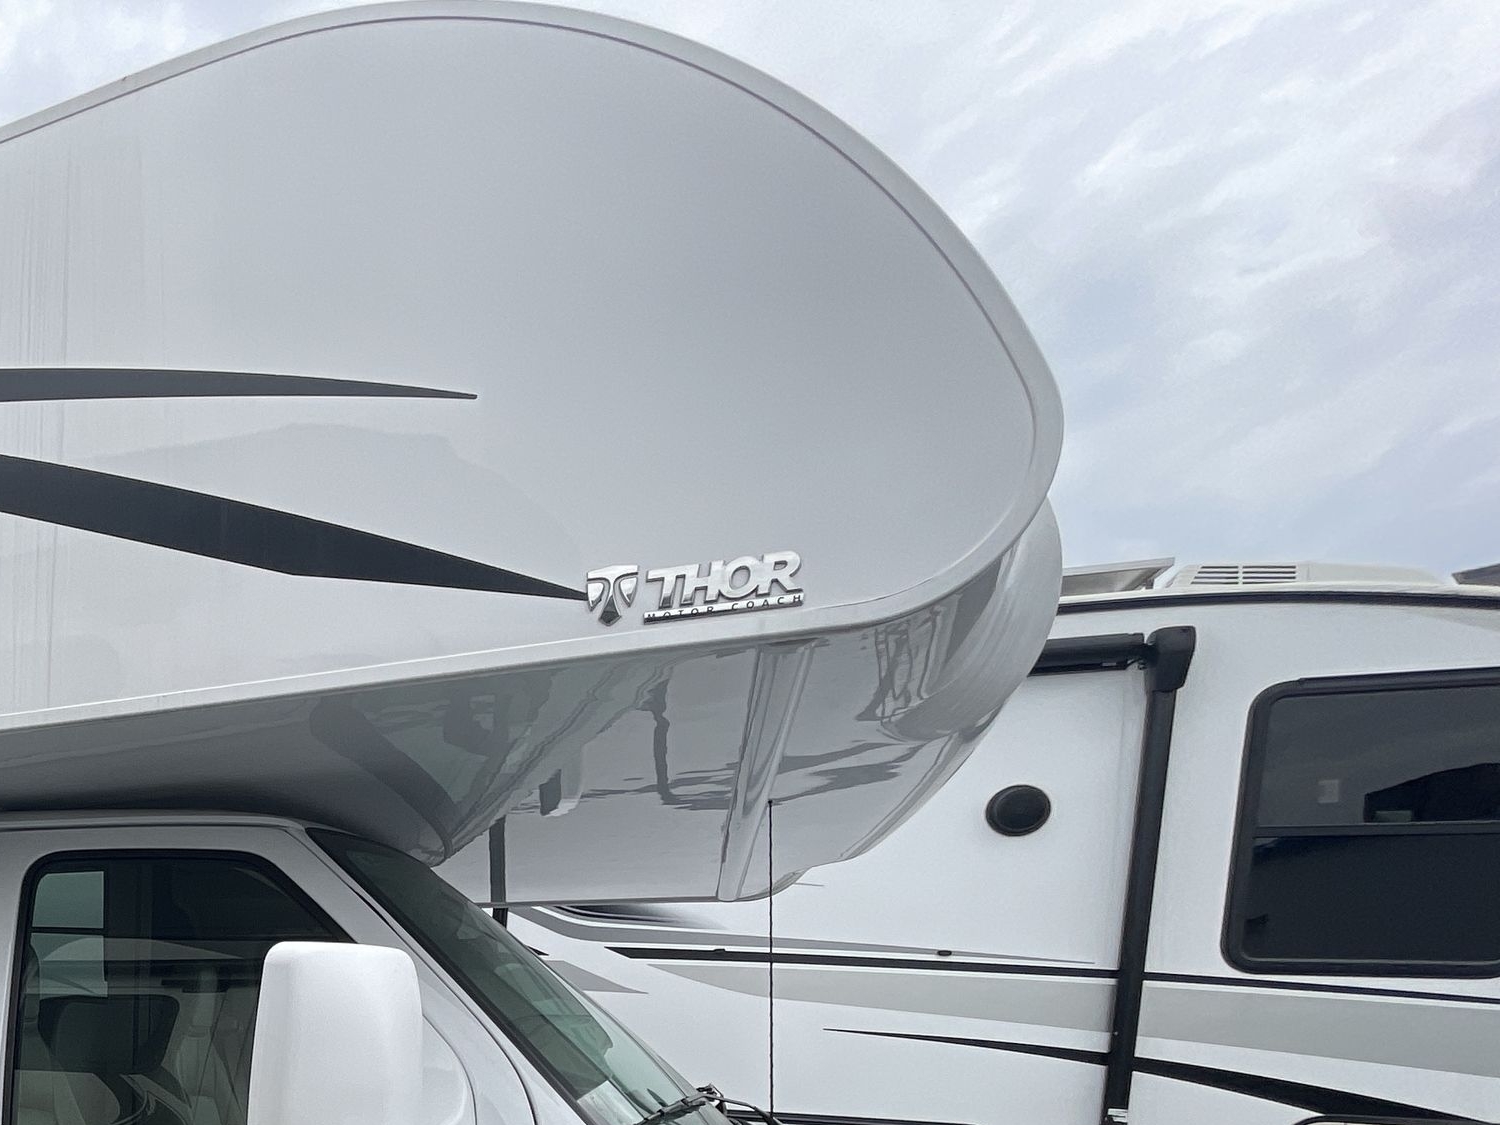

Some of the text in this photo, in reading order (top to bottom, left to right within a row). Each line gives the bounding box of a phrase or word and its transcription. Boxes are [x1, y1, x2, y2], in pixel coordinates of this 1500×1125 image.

[646, 550, 801, 608] THOR
[647, 594, 802, 619] MOTOR COACH
